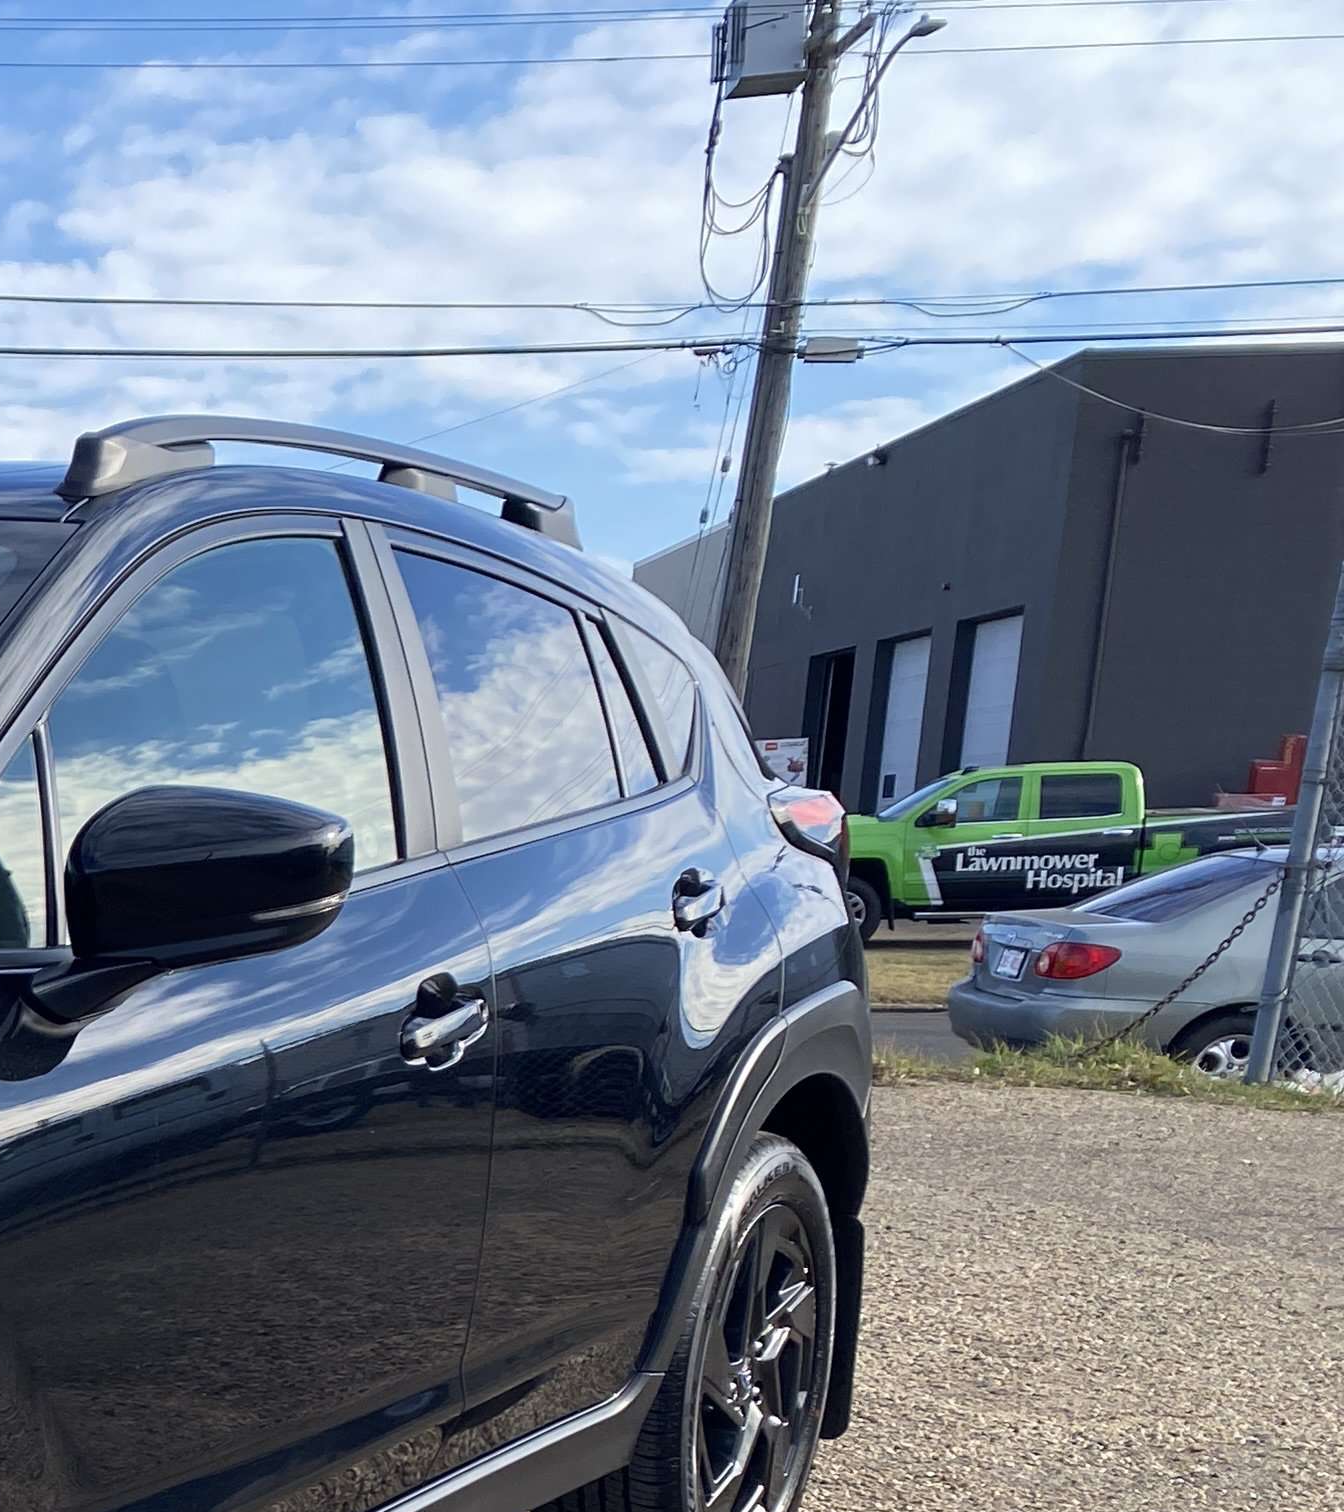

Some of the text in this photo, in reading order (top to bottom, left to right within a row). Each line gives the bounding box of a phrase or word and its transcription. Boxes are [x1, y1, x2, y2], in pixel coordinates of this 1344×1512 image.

[967, 846, 986, 857] the
[955, 853, 1099, 872] Lawnmower
[1026, 866, 1124, 894] Hospital
